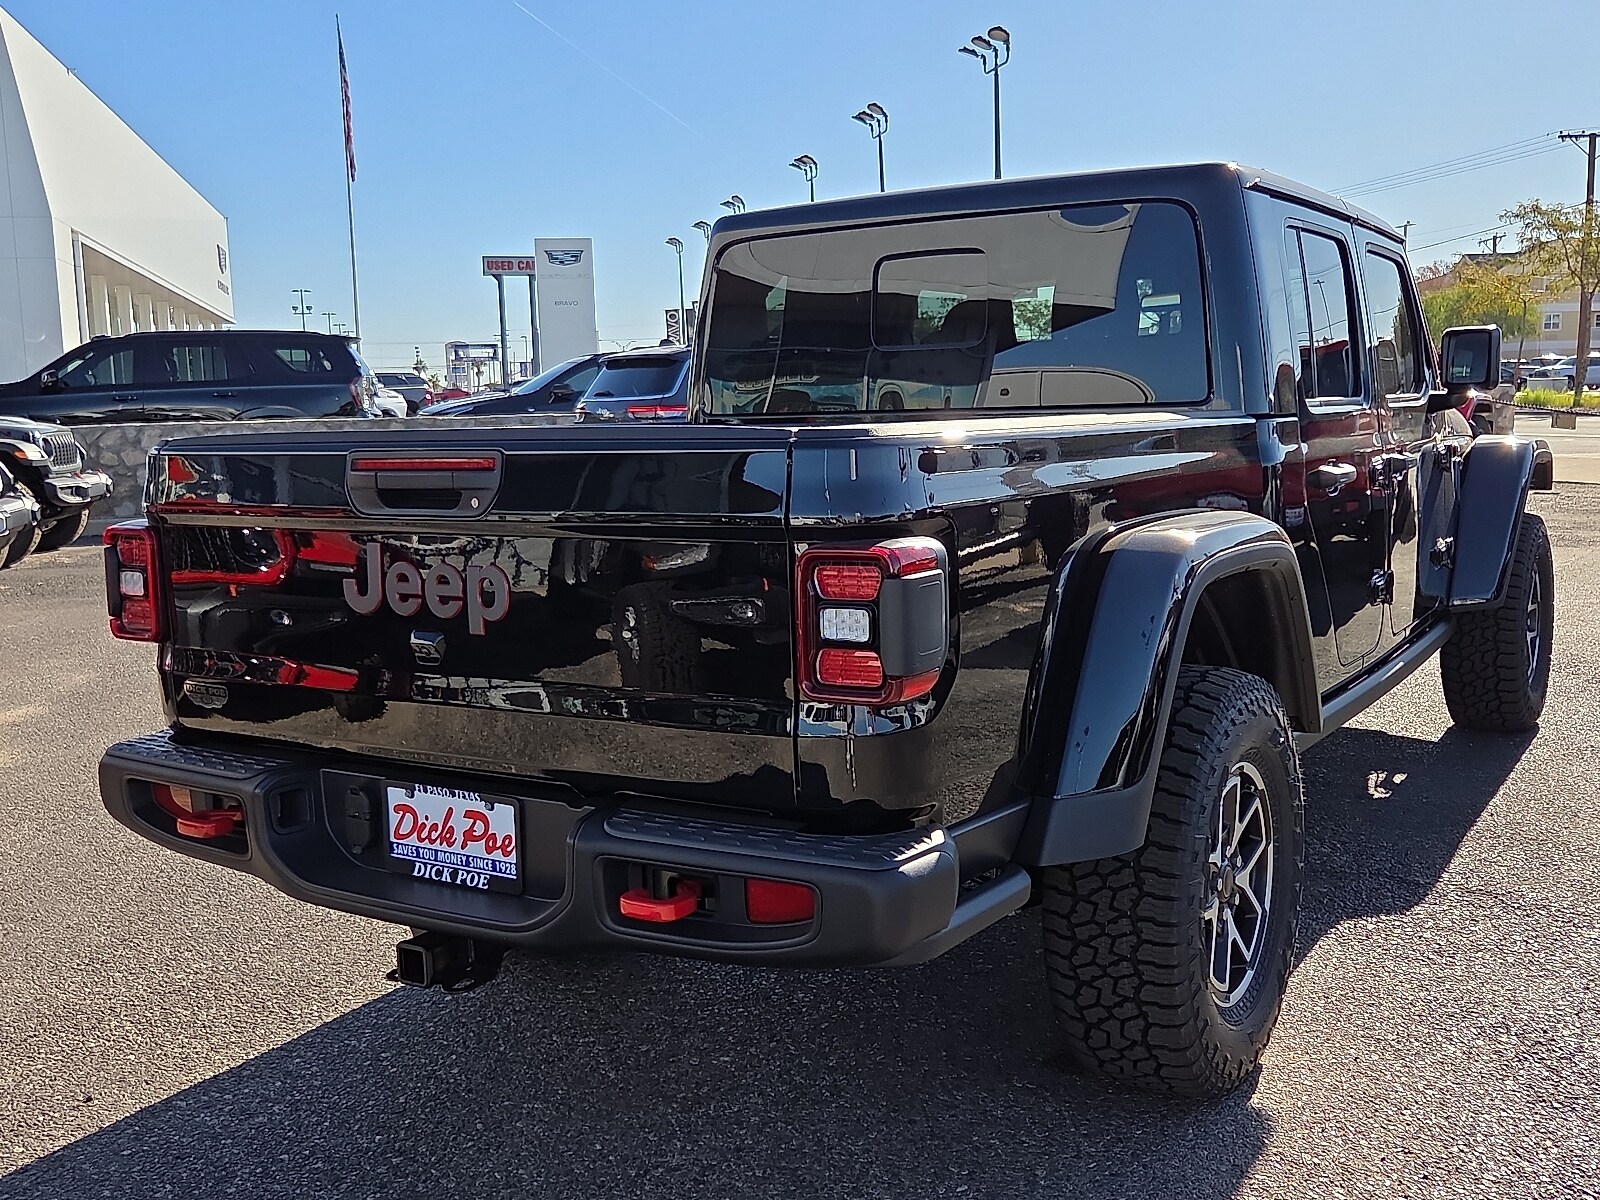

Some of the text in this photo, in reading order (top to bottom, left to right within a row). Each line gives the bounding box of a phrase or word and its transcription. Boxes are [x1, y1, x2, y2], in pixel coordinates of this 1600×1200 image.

[487, 260, 513, 270] USED
[342, 542, 511, 636] Jeep
[186, 684, 226, 697] DICK POE
[392, 803, 516, 858] Dick Poe
[392, 844, 517, 875] SAVES YOU MONEY SINCE 1928
[412, 862, 490, 890] DICK POE
